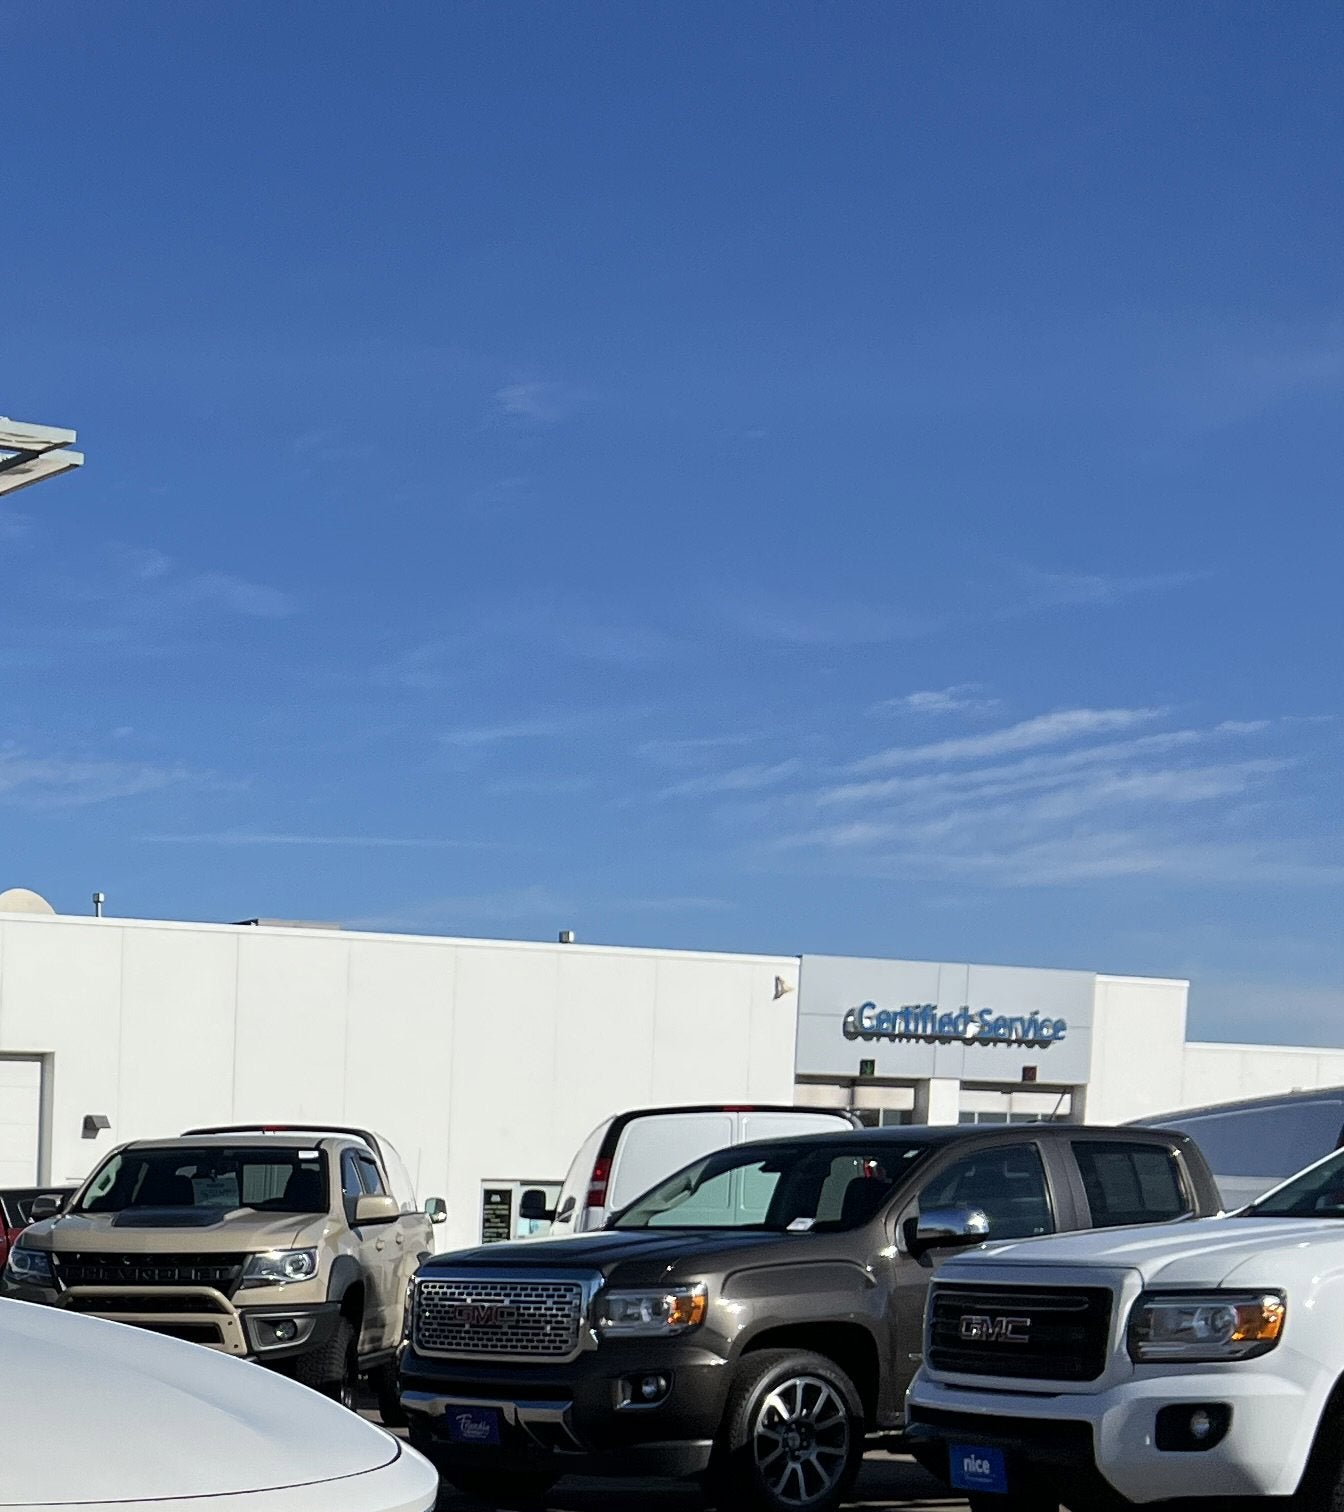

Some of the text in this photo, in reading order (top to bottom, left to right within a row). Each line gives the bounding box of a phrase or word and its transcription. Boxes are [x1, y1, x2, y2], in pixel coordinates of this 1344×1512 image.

[856, 1001, 1068, 1041] Certified Service
[454, 1305, 516, 1325] GMC
[961, 1315, 1031, 1343] GMC
[963, 1454, 991, 1474] nice
